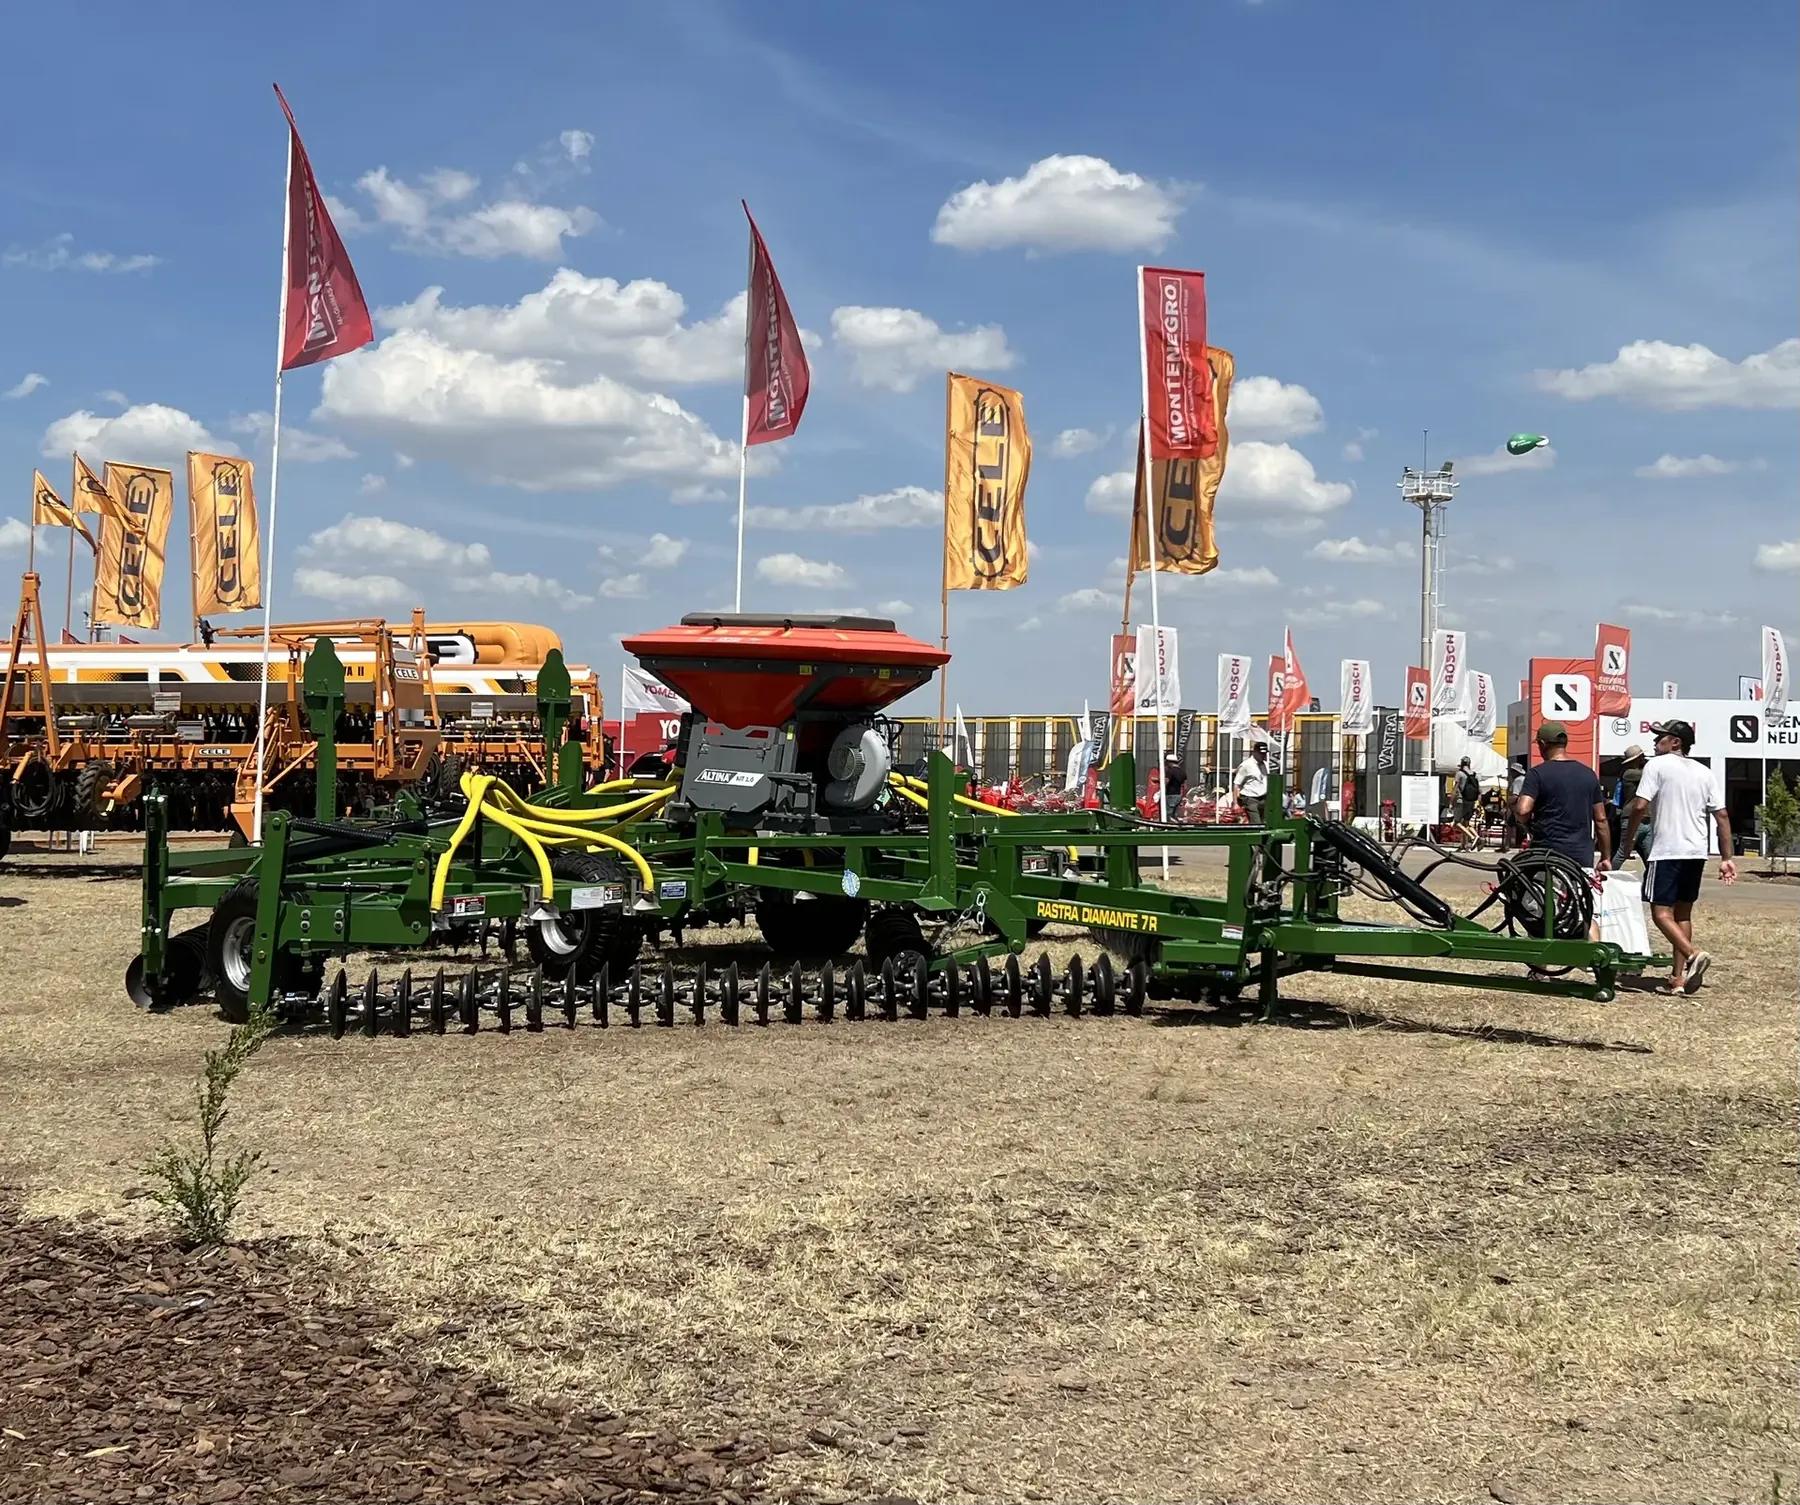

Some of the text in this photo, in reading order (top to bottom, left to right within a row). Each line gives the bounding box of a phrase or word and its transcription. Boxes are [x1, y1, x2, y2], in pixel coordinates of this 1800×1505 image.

[1164, 283, 1190, 446] MONTENEGRO
[978, 402, 1004, 564] CELE
[218, 472, 239, 593] CELE
[396, 669, 418, 679] CELE
[1229, 658, 1240, 700] BOSCH
[1444, 634, 1456, 684] BOSCH
[1477, 674, 1486, 712] BOSCH
[1379, 713, 1397, 770] VALTRA
[1768, 732, 1798, 744] NEU
[701, 771, 731, 782] ALTINA
[1037, 902, 1158, 931] RASTRA DIAMANTE 7R
